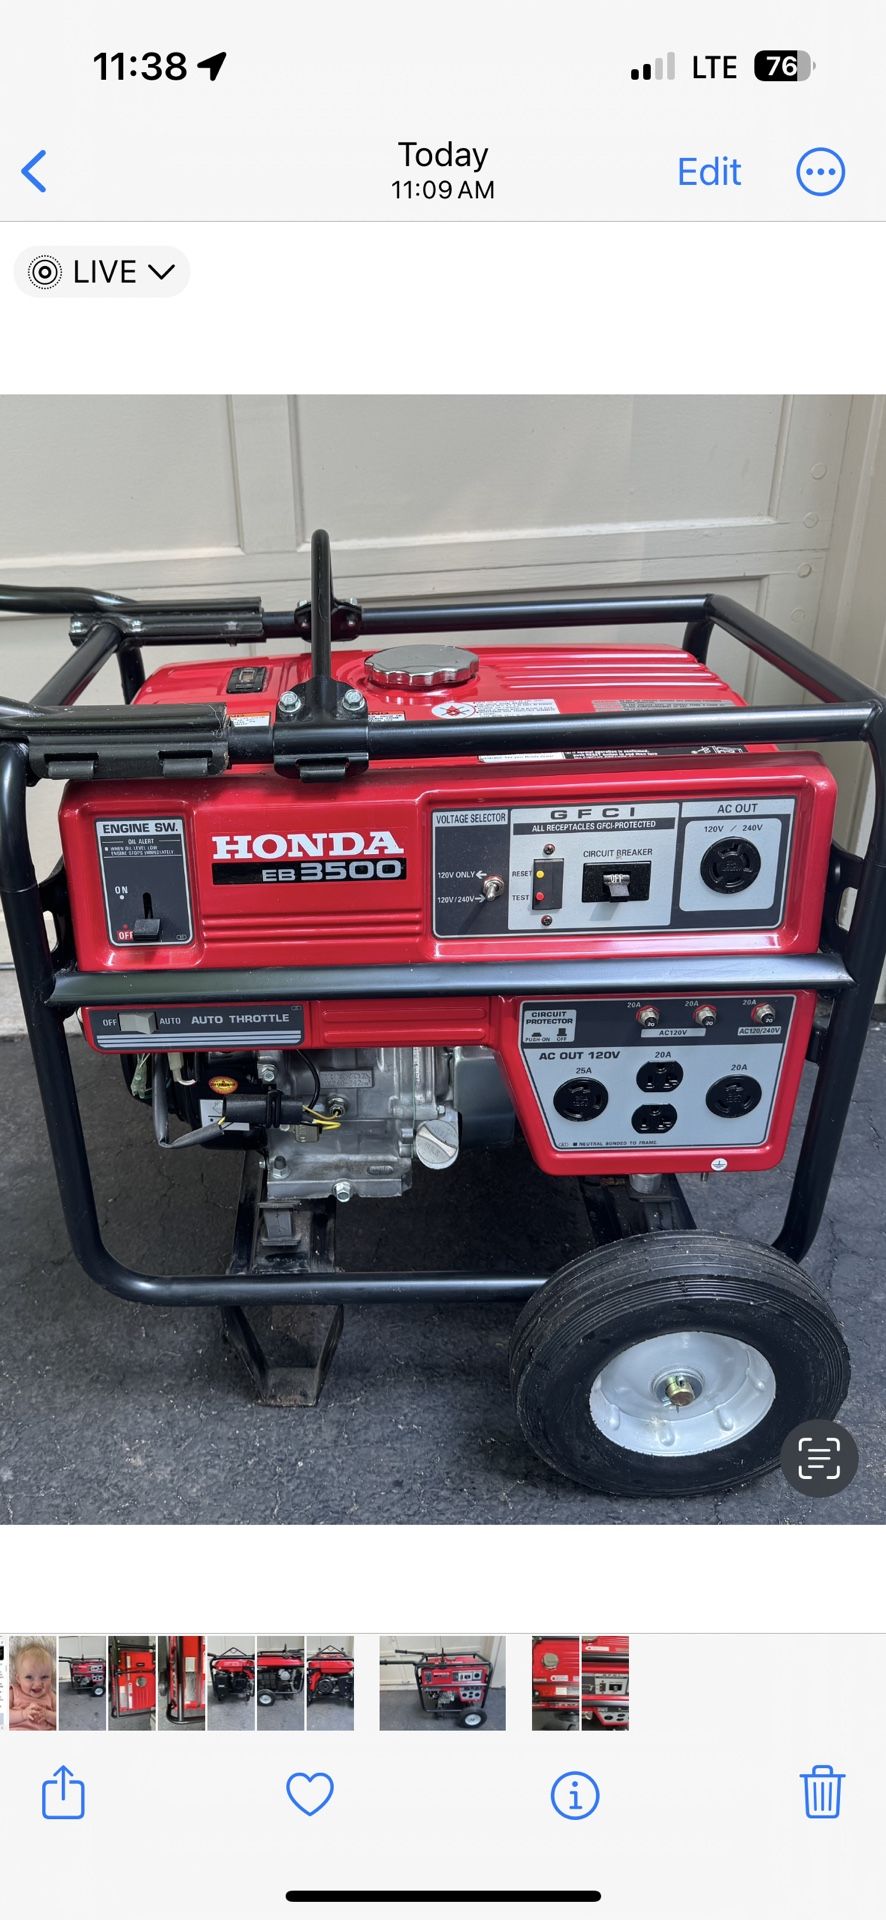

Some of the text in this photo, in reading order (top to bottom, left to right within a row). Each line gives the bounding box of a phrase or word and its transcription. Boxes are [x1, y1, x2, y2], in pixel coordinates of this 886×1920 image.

[93, 52, 188, 81] 11:38
[693, 55, 797, 79] LTE 76
[398, 141, 489, 173] Today
[678, 157, 742, 186] Edit
[392, 181, 495, 200] 11:09 AM
[74, 260, 136, 284] LIVE
[717, 803, 758, 814] AC OUT
[436, 812, 506, 825] VOLTAGE SELECTOR
[102, 822, 178, 834] ENGINE SW.
[531, 820, 656, 833] ALL RECEPTACLES GFCI-PROTECTED
[704, 825, 724, 833] 120V
[742, 824, 764, 832] 240V
[211, 830, 404, 860] HONDA
[583, 848, 653, 858] CIRCUIT BREAKER
[262, 860, 402, 882] EB 3500
[437, 870, 476, 879] 120V ONLY
[511, 870, 532, 878] RESET
[115, 886, 129, 894] ON
[437, 895, 476, 903] 120V/240V
[102, 1019, 117, 1027] OFF
[159, 1017, 181, 1025] AUTO
[191, 1014, 290, 1025] AUTO THROTTLE
[539, 1051, 621, 1060] AC OUT 120V
[654, 1051, 672, 1059] 20A
